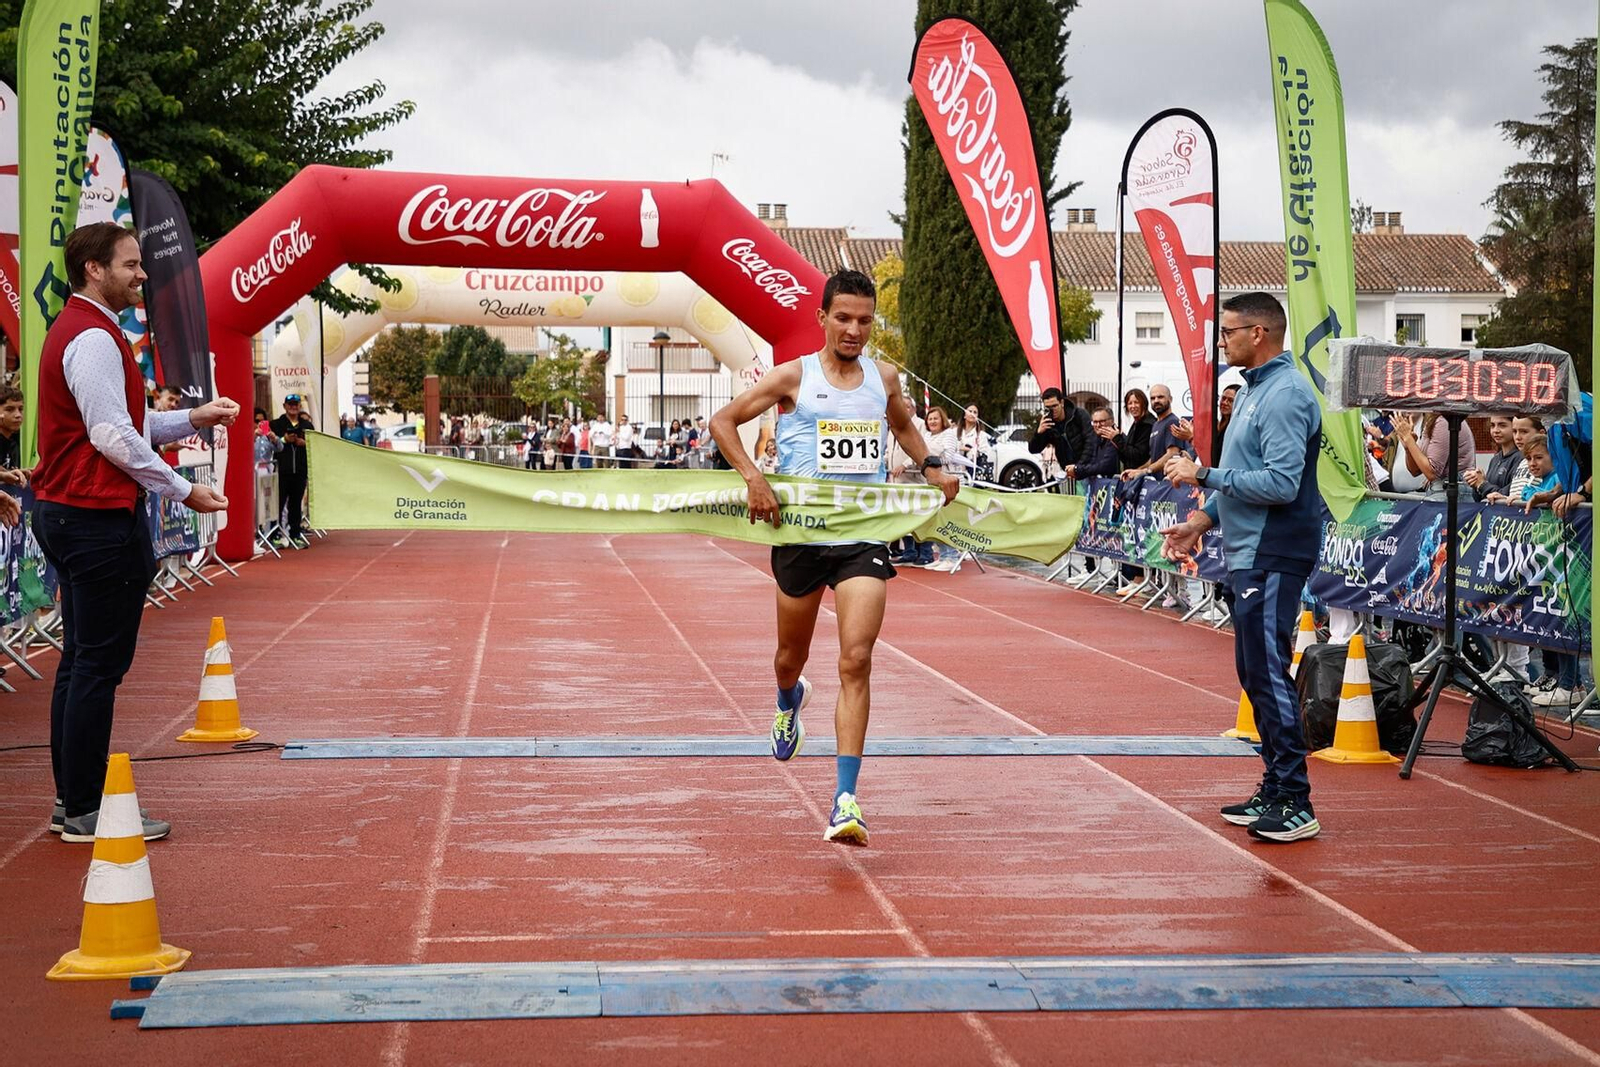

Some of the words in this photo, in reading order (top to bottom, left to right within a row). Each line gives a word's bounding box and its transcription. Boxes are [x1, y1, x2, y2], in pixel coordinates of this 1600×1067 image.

[398, 184, 608, 249] Coca-Cola
[231, 216, 314, 303] Coca-Cola
[465, 268, 604, 296] Cruzcampo
[721, 238, 812, 311] Coca-Cola
[480, 298, 546, 320] Radler
[1386, 356, 1556, 404] 00:30:38
[827, 422, 839, 432] 38
[820, 438, 880, 459] 3013
[394, 509, 410, 520] de
[412, 509, 468, 522] Granada
[396, 497, 466, 514] Diputación
[936, 526, 949, 537] de
[945, 521, 992, 546] Diputación
[1322, 535, 1364, 569] FONDO
[1480, 537, 1575, 585] FONDO
